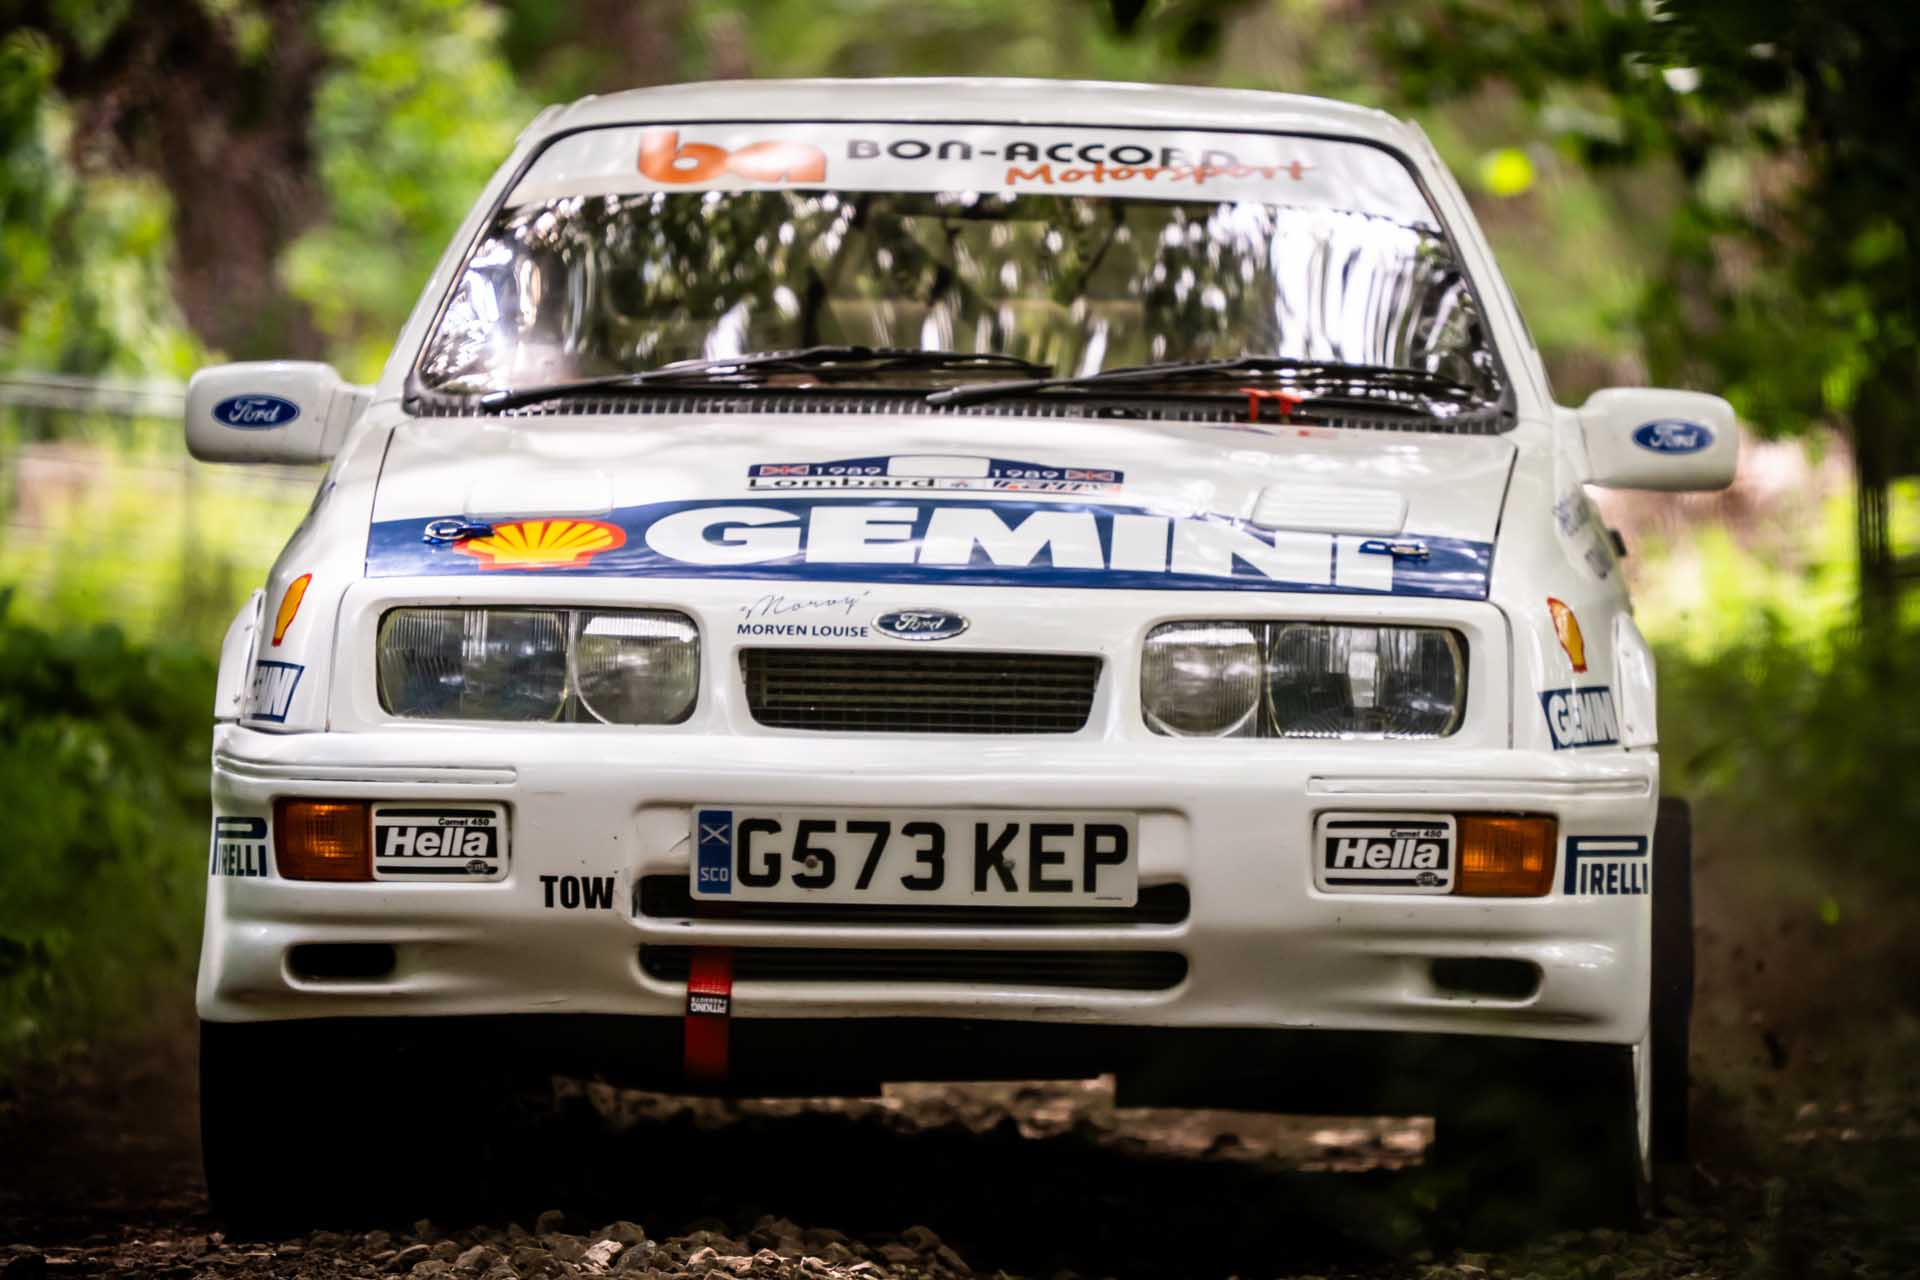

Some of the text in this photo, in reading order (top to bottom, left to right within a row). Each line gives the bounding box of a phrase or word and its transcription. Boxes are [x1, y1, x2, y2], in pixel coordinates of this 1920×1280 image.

[1005, 161, 1316, 185] Motorsport
[229, 400, 280, 422] Ford
[1649, 424, 1698, 447] Ford
[815, 466, 882, 476] 1989
[992, 468, 1060, 479] 1989
[748, 478, 935, 488] Lombard
[644, 504, 1394, 591] GEMINI
[737, 624, 869, 637] MORVEN LOUISE
[893, 613, 947, 632] Ford
[211, 816, 268, 877] PIRELLI
[384, 826, 489, 857] Hella
[736, 817, 1129, 894] G573 KEP
[1334, 838, 1440, 869] Hella
[700, 867, 729, 883] SCO
[1562, 835, 1649, 896] PIRELLI
[539, 874, 615, 910] TOW
